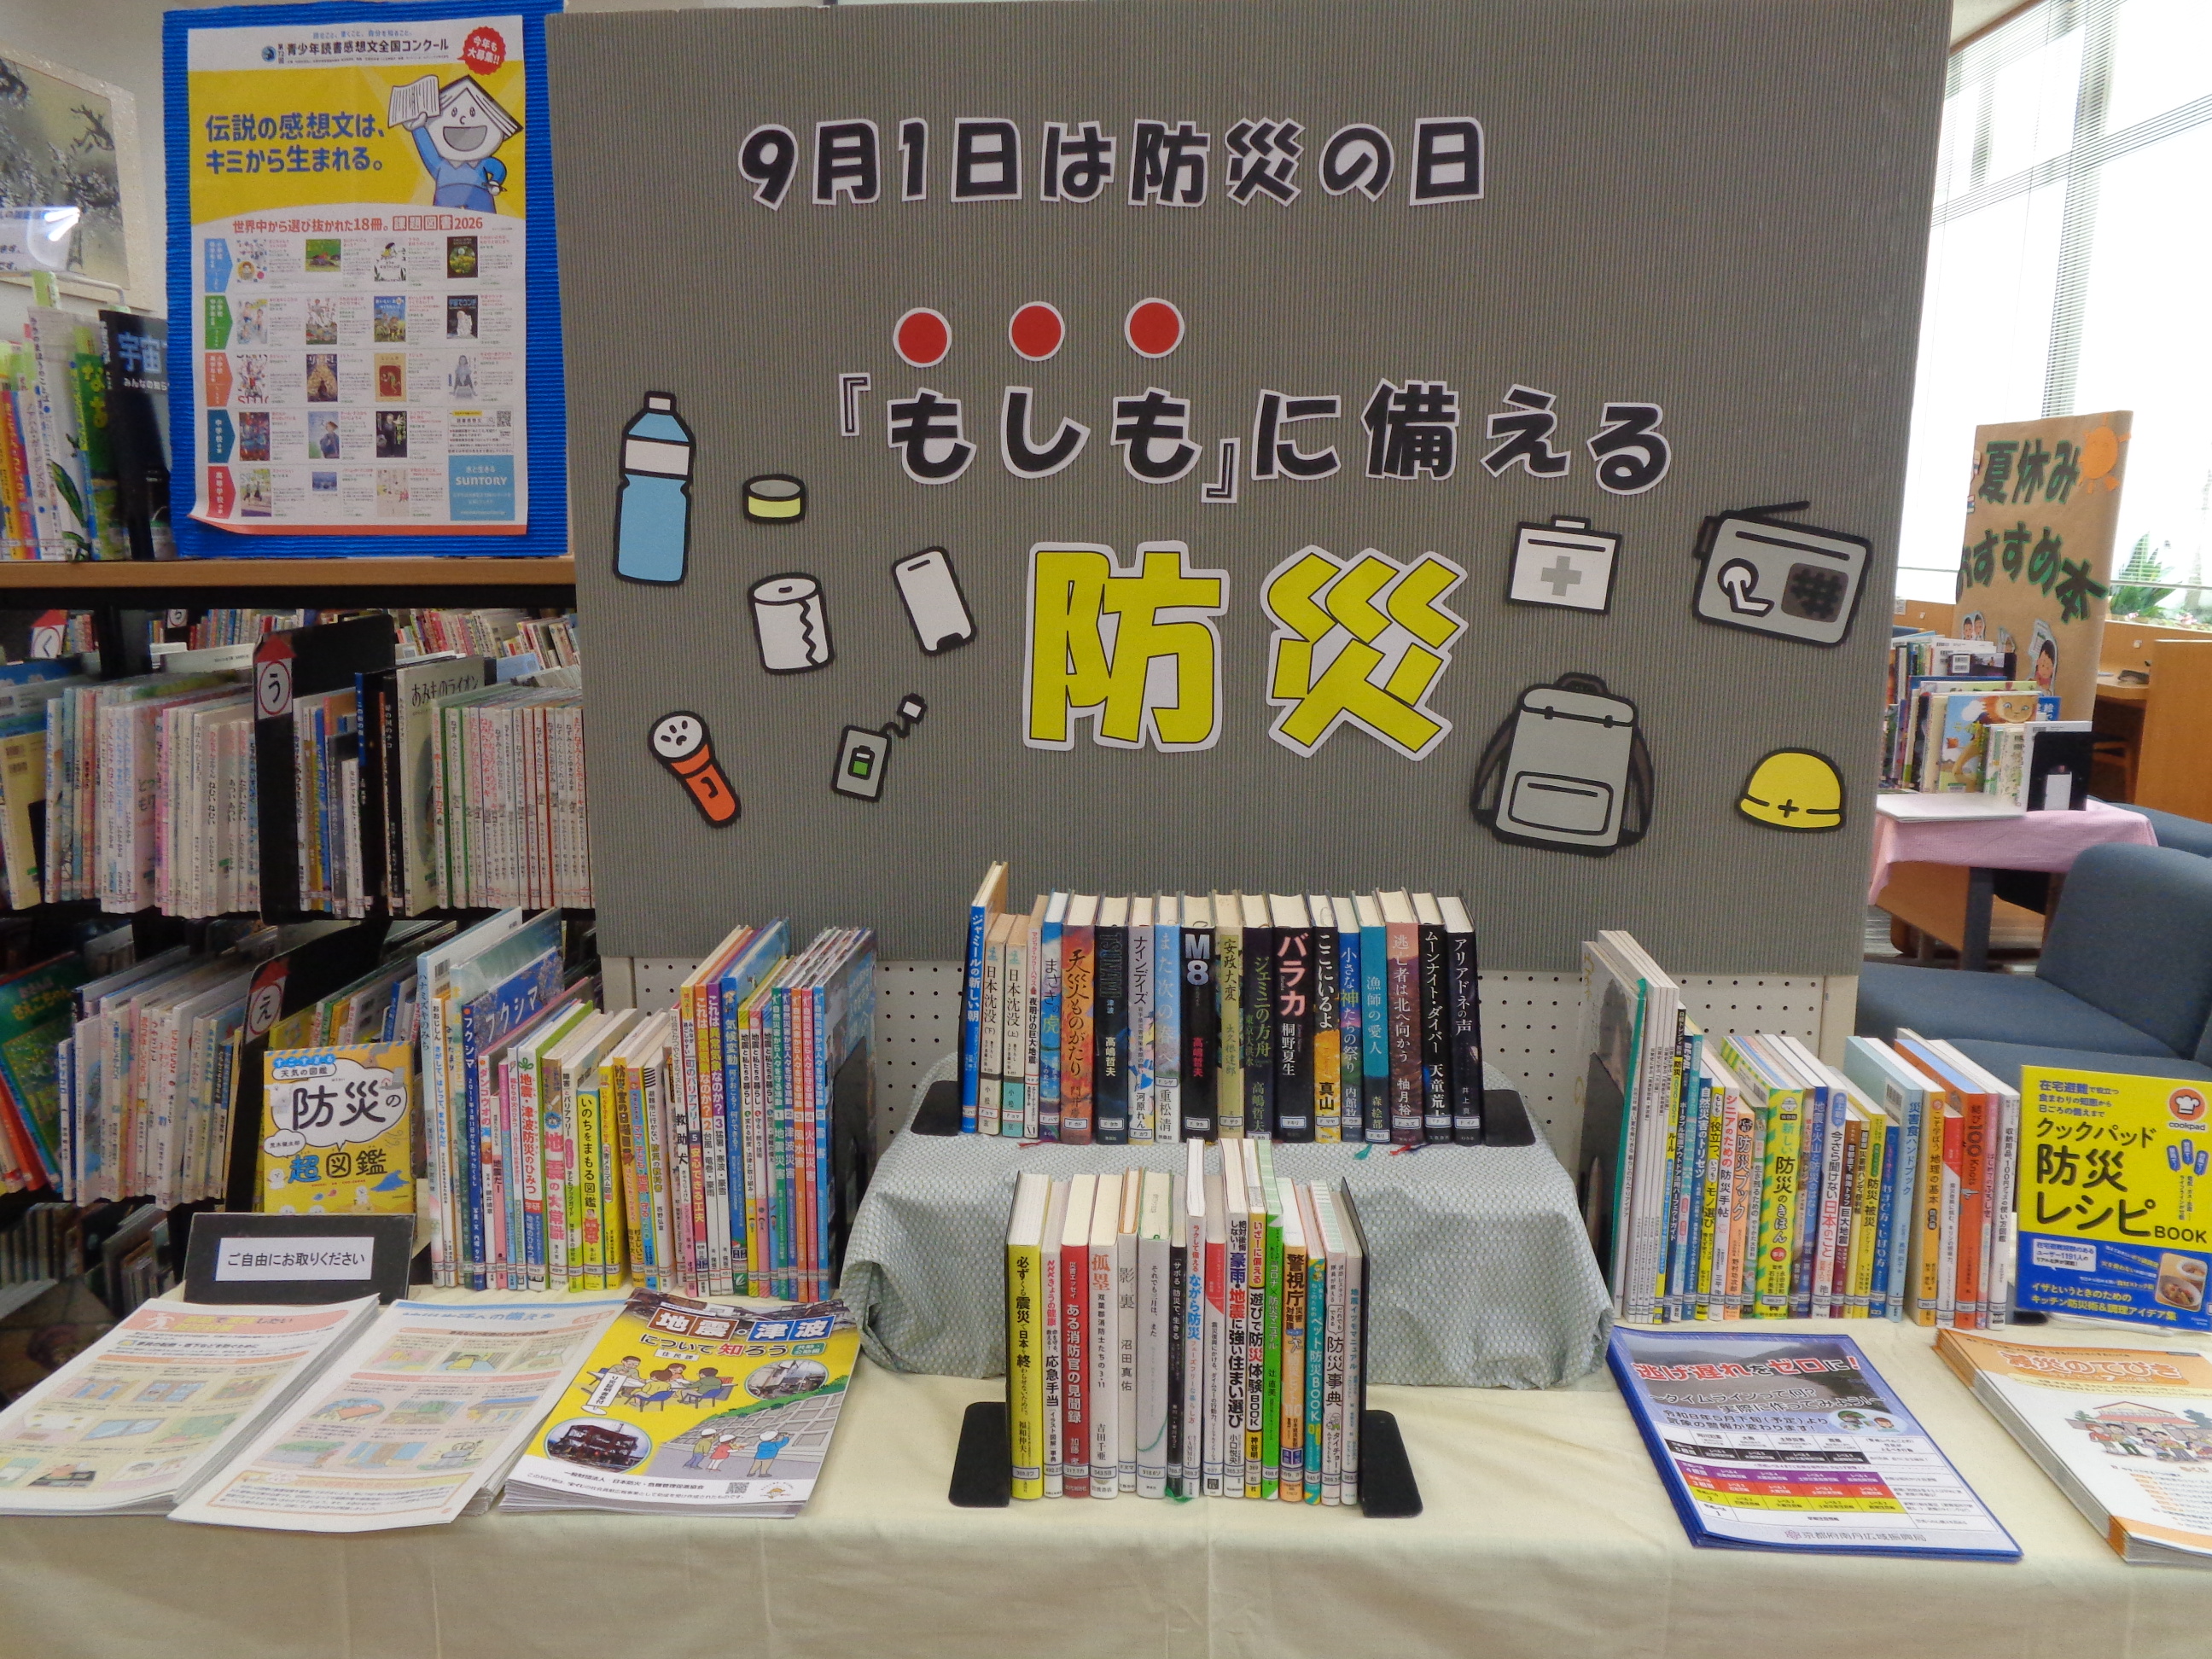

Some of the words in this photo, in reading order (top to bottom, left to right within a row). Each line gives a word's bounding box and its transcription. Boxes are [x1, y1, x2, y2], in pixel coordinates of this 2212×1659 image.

[287, 40, 450, 55] 青少年読書感想文全国コンクール
[467, 46, 500, 66] 大募集!!
[473, 37, 498, 51] 今年も
[206, 112, 385, 143] 伝説の感想文は、
[206, 146, 383, 175] キミから生まれる。
[739, 118, 1483, 209] 9月1日は防災の日
[233, 218, 389, 234] 世界中から選び抜かれた18冊。
[118, 331, 168, 374] 宇宙
[124, 377, 169, 390] みんなの知ら
[842, 375, 1669, 500] 『もしも』に備える
[455, 476, 508, 486] SUNTORY
[1978, 439, 2082, 505] 夏休み
[1027, 549, 1473, 754] 防災
[268, 672, 282, 704] う
[967, 915, 983, 1022] ジャミールの新しい朝
[1099, 932, 1123, 998] TSUNAMI
[1132, 936, 1149, 1005] ナインデイズ
[1185, 934, 1210, 986] M8
[1223, 939, 1238, 1002] 安政大変
[1277, 932, 1308, 1017] バラカ
[1318, 934, 1334, 1030] ここにいるよ
[258, 1002, 271, 1024] え
[419, 975, 430, 1051] ハナミズキのみち
[1043, 958, 1062, 1034] まさきの虎
[1065, 948, 1091, 1076] 天災ものがたり
[1157, 932, 1174, 1063] また次の春へ
[1254, 957, 1272, 1058] ジェミニの方舟
[1340, 946, 1359, 1074] 小さな神たちの祭り
[1392, 934, 1411, 1063] 逃亡者は北へ向かう
[1424, 930, 1444, 1055] ムーンナイト・ダイバー
[1454, 938, 1473, 1036] アリアドネの声
[433, 1005, 441, 1041] おおじしん
[486, 986, 539, 1043] フクシマ
[1027, 997, 1038, 1065] 夜明けの巨大地震
[1366, 975, 1382, 1056] 漁師の愛人
[273, 1054, 336, 1068] すごすぎる
[463, 1017, 474, 1069] フクシマ
[696, 997, 712, 1116] これは異常気象なのか?
[707, 994, 723, 1115] これは異常気象なのか?
[725, 1019, 738, 1066] 気候変動
[772, 1005, 783, 1106] 自然災害から人々を守る活動
[783, 1005, 793, 1106] 自然災害から人々を守る活動
[793, 1007, 803, 1109] 自然災害から人々を守る活動
[803, 1007, 813, 1109] 自然災害から人々を守る活動
[813, 1006, 824, 1109] 自然災害から人々を守る活動
[1105, 1037, 1117, 1077] 高嶋哲夫
[1192, 1037, 1203, 1077] 高嶋哲夫
[1245, 1015, 1254, 1068] 東京大洪水
[1281, 1023, 1295, 1076] 桐野夏生
[280, 1066, 329, 1078] 天気の図鑑
[685, 1059, 698, 1130] 町のバリアフリー
[741, 1033, 751, 1106] 地震と私たちの暮らし
[751, 1033, 761, 1105] 地震と私たちの暮らし
[764, 1033, 774, 1104] 地震と私たちの暮らし
[2038, 1079, 2121, 1096] 在宅避難で役立つ
[292, 1079, 403, 1131] 防災の
[434, 1045, 446, 1148] さがして、はしって、まもるんだ
[1136, 1092, 1146, 1129] 河原れん
[1159, 1089, 1172, 1132] 重松清
[1252, 1081, 1266, 1132] 高嶋哲夫
[1318, 1081, 1335, 1116] 真山
[1345, 1087, 1357, 1116] 内館牧
[1371, 1096, 1383, 1129] 森絵都
[1396, 1078, 1412, 1116] 柚月裕
[1462, 1086, 1470, 1115] 井上真
[2038, 1093, 2113, 1108] 食まわりの知恵から
[2038, 1104, 2106, 1119] 日ごろの備えまで
[269, 1140, 300, 1150] 荒木健太郎
[520, 1074, 537, 1194] 地震・津波防災のひみつ
[581, 1097, 597, 1208] いのちをまもる図鑑
[675, 1114, 690, 1165] 救助犬
[754, 1117, 763, 1158] 守る・救う技術
[784, 1126, 795, 1179] 津波災害
[795, 1128, 805, 1168] 風水害
[816, 1127, 826, 1160] 雪害
[1695, 1087, 1711, 1179] 自然災害のトリセツ
[1902, 1101, 1921, 1196] 災害食ハンドブック
[2036, 1117, 2157, 1149] クックパッド
[2168, 1121, 2207, 1132] cookpad
[288, 1149, 388, 1184] 超図鑑
[703, 1132, 715, 1197] 台風・竜巻・豪雨
[715, 1130, 727, 1196] 猛暑・寒波・豪雪
[745, 1117, 754, 1192] 変わる制度・法律と取り組み
[774, 1128, 785, 1180] 地震災害
[805, 1130, 816, 1182] 火山災害
[1732, 1134, 1753, 1221] 防災ブック
[1928, 1153, 1941, 1205] 地理の基本
[2036, 1143, 2129, 1194] 防災
[544, 1131, 566, 1241] 地震の大常識
[690, 1147, 705, 1223] 安心できる工夫
[1703, 1187, 1717, 1229] モノ選び
[1237, 1220, 1247, 1252] 絶対後悔
[1838, 1208, 1851, 1245] 巨大地震
[2036, 1190, 2157, 1237] レシピ
[2153, 1225, 2209, 1244] BOOK
[227, 1251, 365, 1267] ご自由にお取りください
[1091, 1254, 1110, 1291] 孤塁
[1191, 1225, 1200, 1272] ラクして備える
[2036, 1250, 2089, 1261] ユーザー1191人の
[1119, 1267, 1135, 1309] 影裏
[1286, 1254, 1305, 1307] 警視庁
[2031, 1282, 2133, 1303] イザというときのための
[654, 1312, 830, 1339] 地震・津波
[1187, 1274, 1202, 1341] ながら防災
[1349, 1288, 1359, 1370] 地震イツモマニュアル
[2031, 1295, 2178, 1322] キッチン防災術&調理アイデア集
[639, 1333, 789, 1358] について知ろう
[661, 1351, 695, 1360] 住民課
[1067, 1304, 1081, 1423] ある消防官の見聞録
[1121, 1339, 1132, 1392] 沼田真佑
[1227, 1252, 1247, 1429] 豪雨・地震に強い住まい選び
[1248, 1292, 1264, 1427] 遊びで防災体験BOOK
[1045, 1355, 1059, 1407] 応急手当
[1309, 1317, 1324, 1423] ペット防災BOOK
[1326, 1336, 1344, 1406] 防災事典
[1631, 1355, 1861, 1382] 逃げ遅れをゼロに!
[1097, 1423, 1106, 1461] 吉田千亜
[1662, 1409, 1829, 1425] 令和8年5月下旬(予定)より
[1667, 1417, 1815, 1433] 気象の警報が変わります!
[563, 1470, 606, 1482] 一般財団法人
[1333, 1433, 1342, 1469] タイチョー
